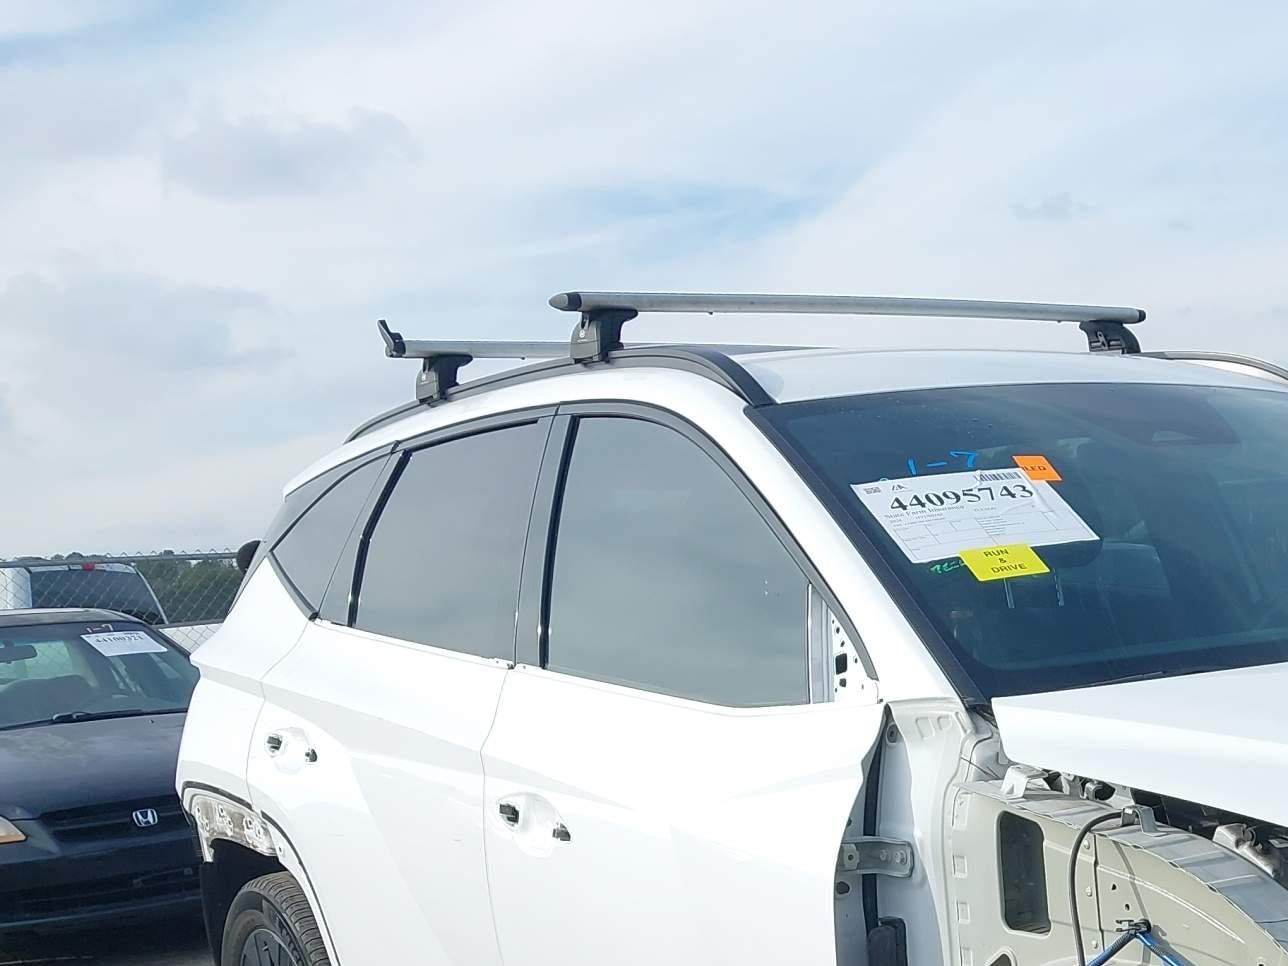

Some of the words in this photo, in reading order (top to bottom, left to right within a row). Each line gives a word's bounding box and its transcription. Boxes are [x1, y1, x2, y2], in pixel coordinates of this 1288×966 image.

[890, 484, 1034, 511] 44095743
[983, 548, 1009, 558] RUN
[991, 563, 1028, 574] DRIVE
